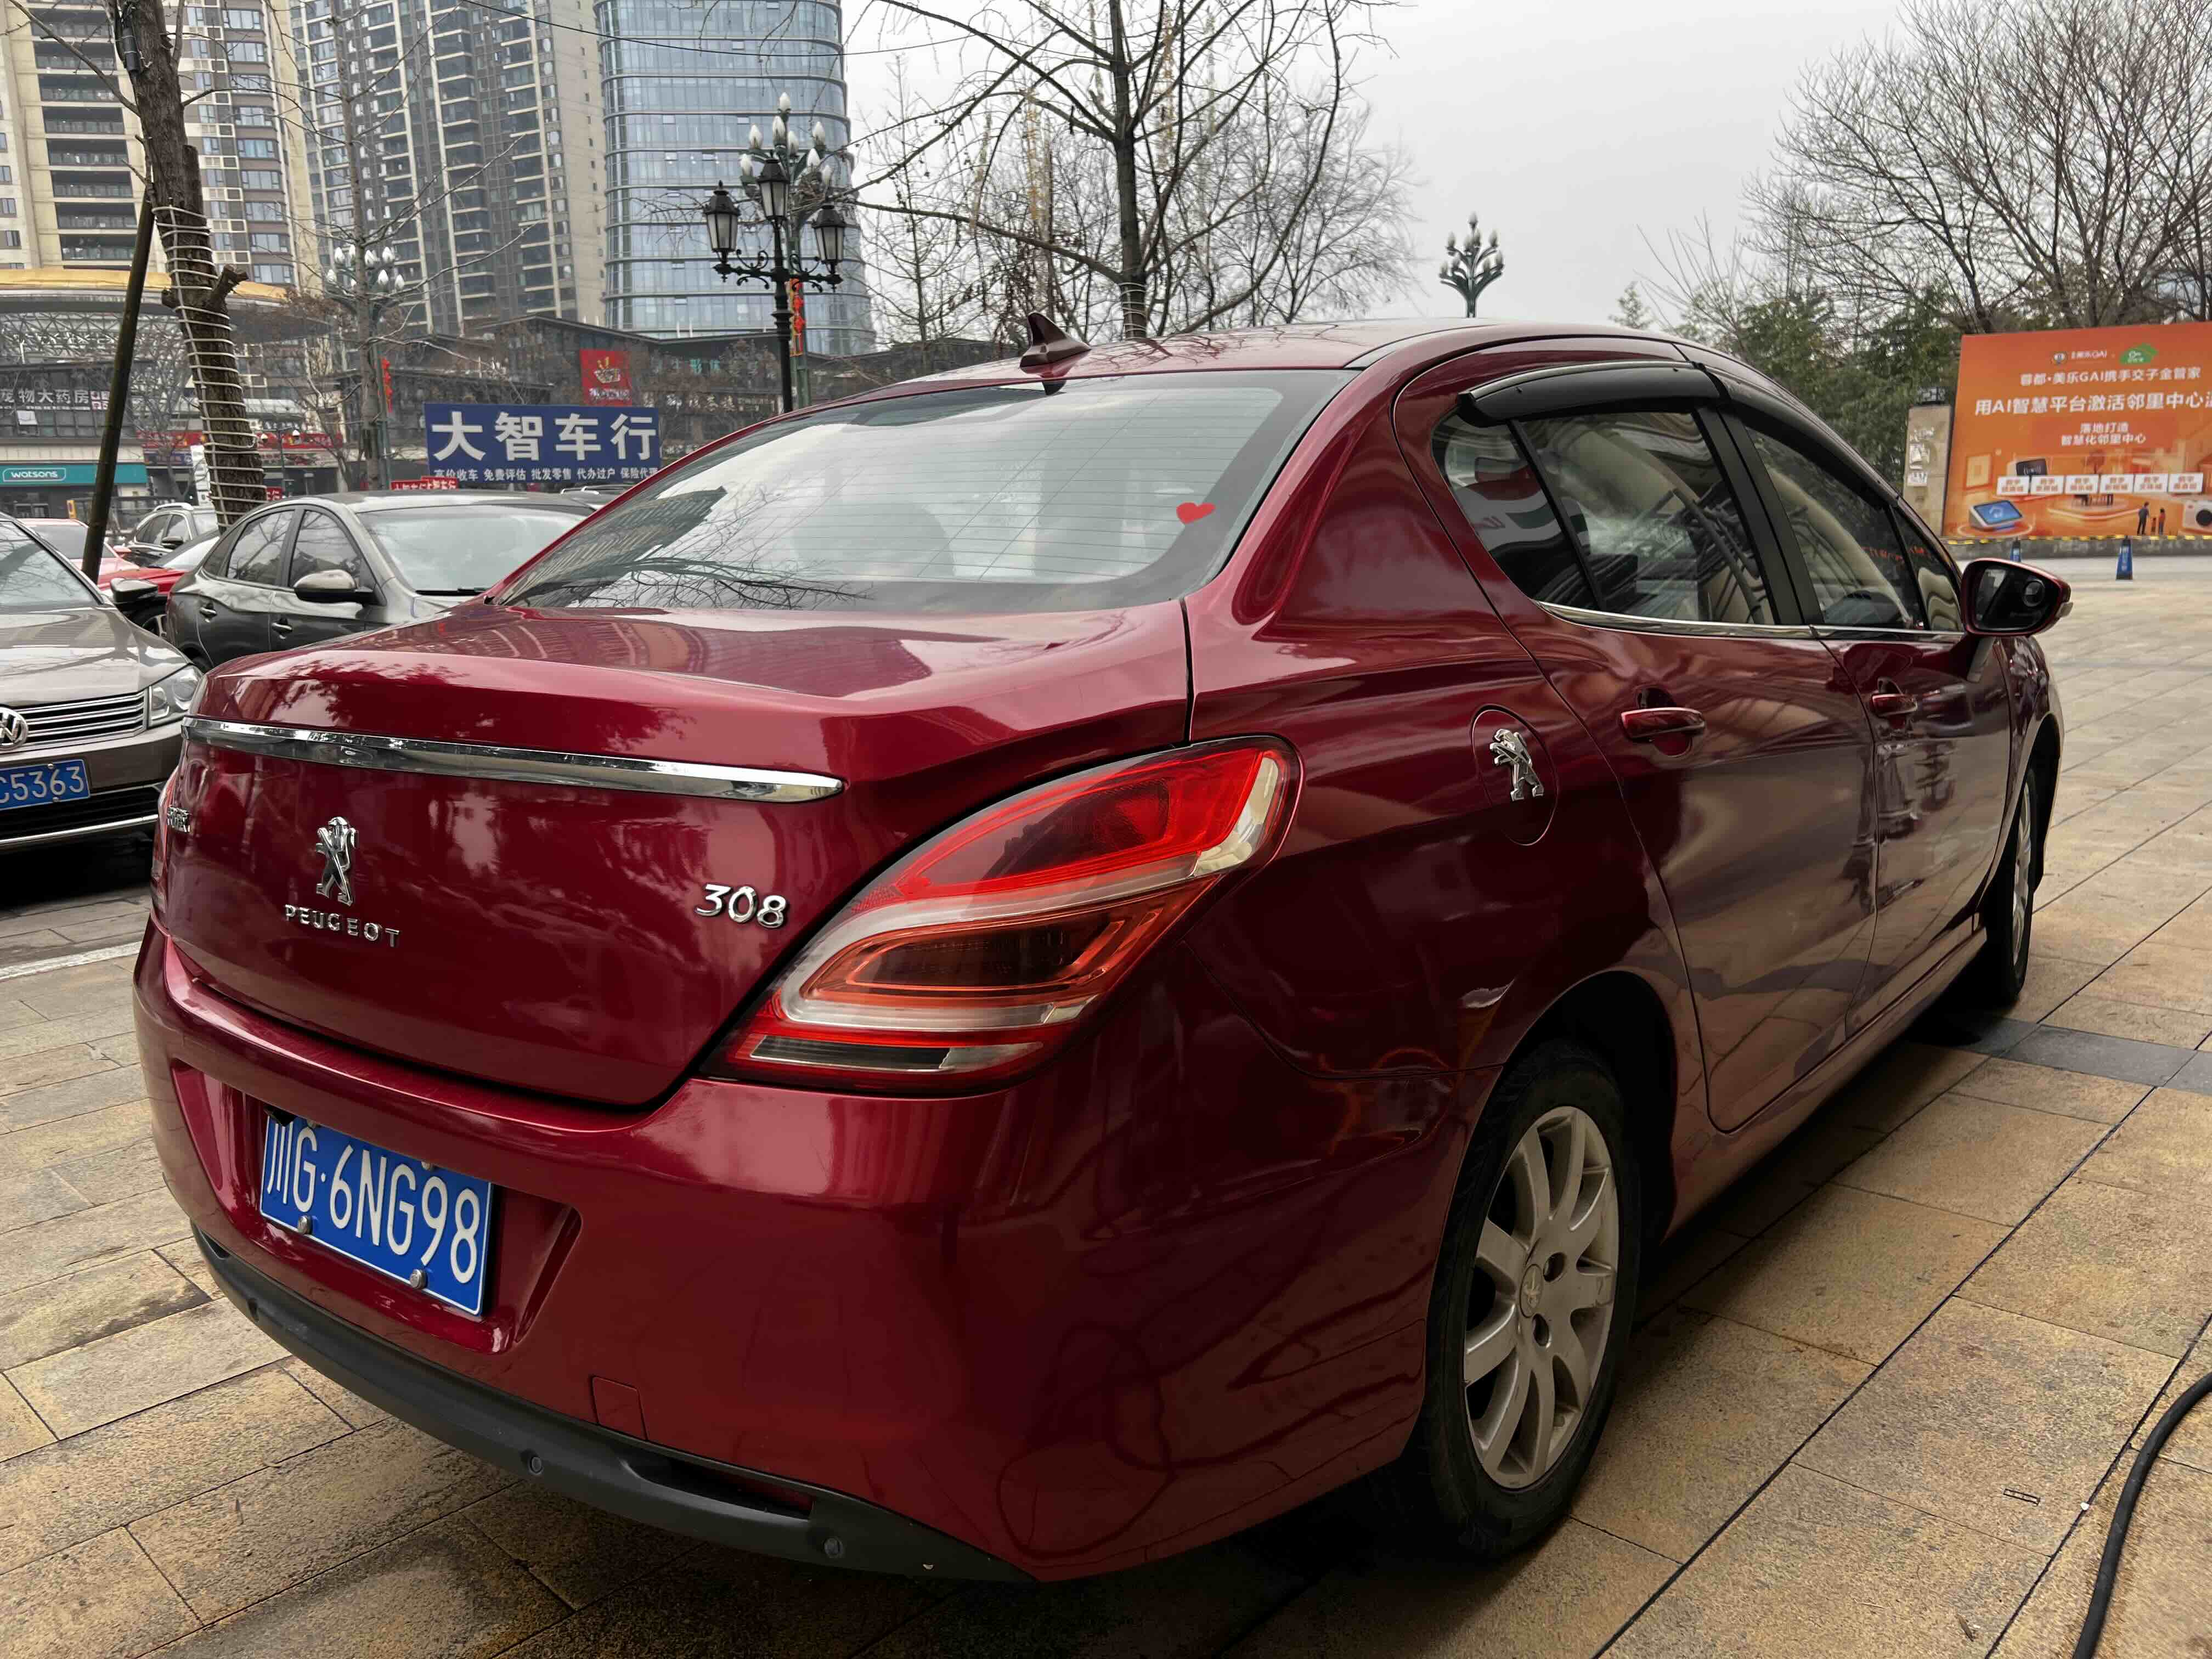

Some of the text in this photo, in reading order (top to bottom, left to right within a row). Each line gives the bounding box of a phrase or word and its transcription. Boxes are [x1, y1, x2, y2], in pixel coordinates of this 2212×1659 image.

[432, 411, 657, 462] 大智车行
[11, 470, 58, 478] watsons
[434, 469, 478, 481] 高价收车
[484, 469, 526, 481] 免费评估
[531, 468, 572, 480] 批发零售
[577, 468, 616, 479] 代办过户
[284, 904, 402, 947] PEUGEOT
[695, 883, 787, 928] 308
[267, 1122, 481, 1284] 川G·6NG98
